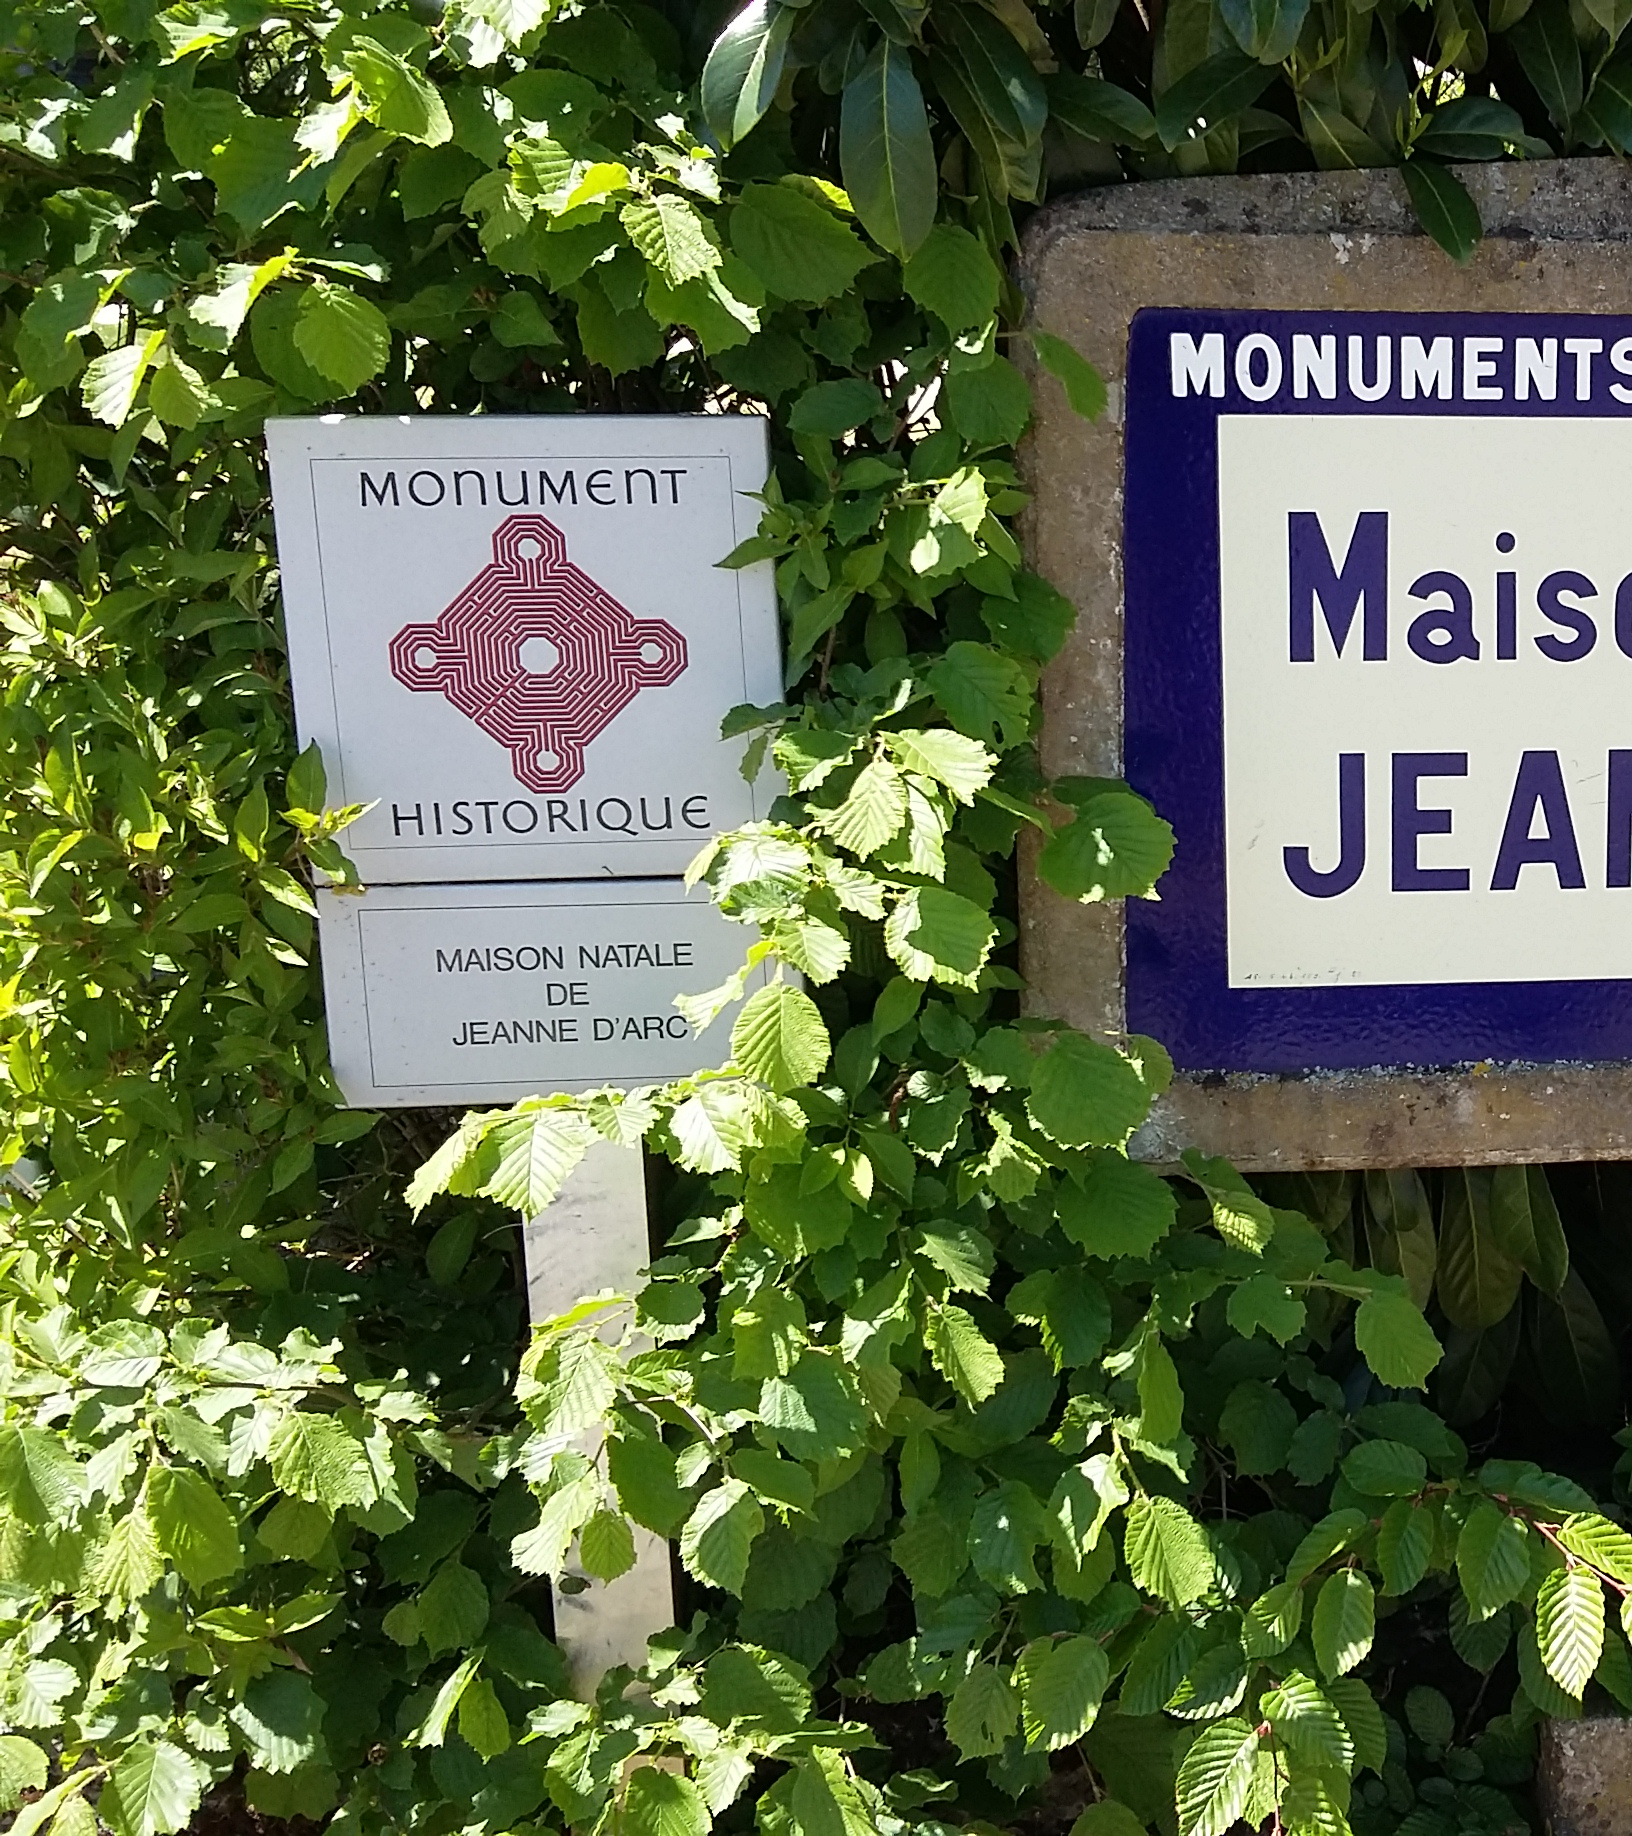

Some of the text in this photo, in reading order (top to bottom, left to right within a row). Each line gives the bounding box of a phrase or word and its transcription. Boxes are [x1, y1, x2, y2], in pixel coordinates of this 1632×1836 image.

[359, 467, 689, 508] MONUMENT
[390, 794, 712, 838] HISTORIQUE
[435, 941, 695, 974] MAISON NATALE
[545, 981, 591, 1008] DE
[451, 1013, 689, 1047] JEANNE D'ARC
